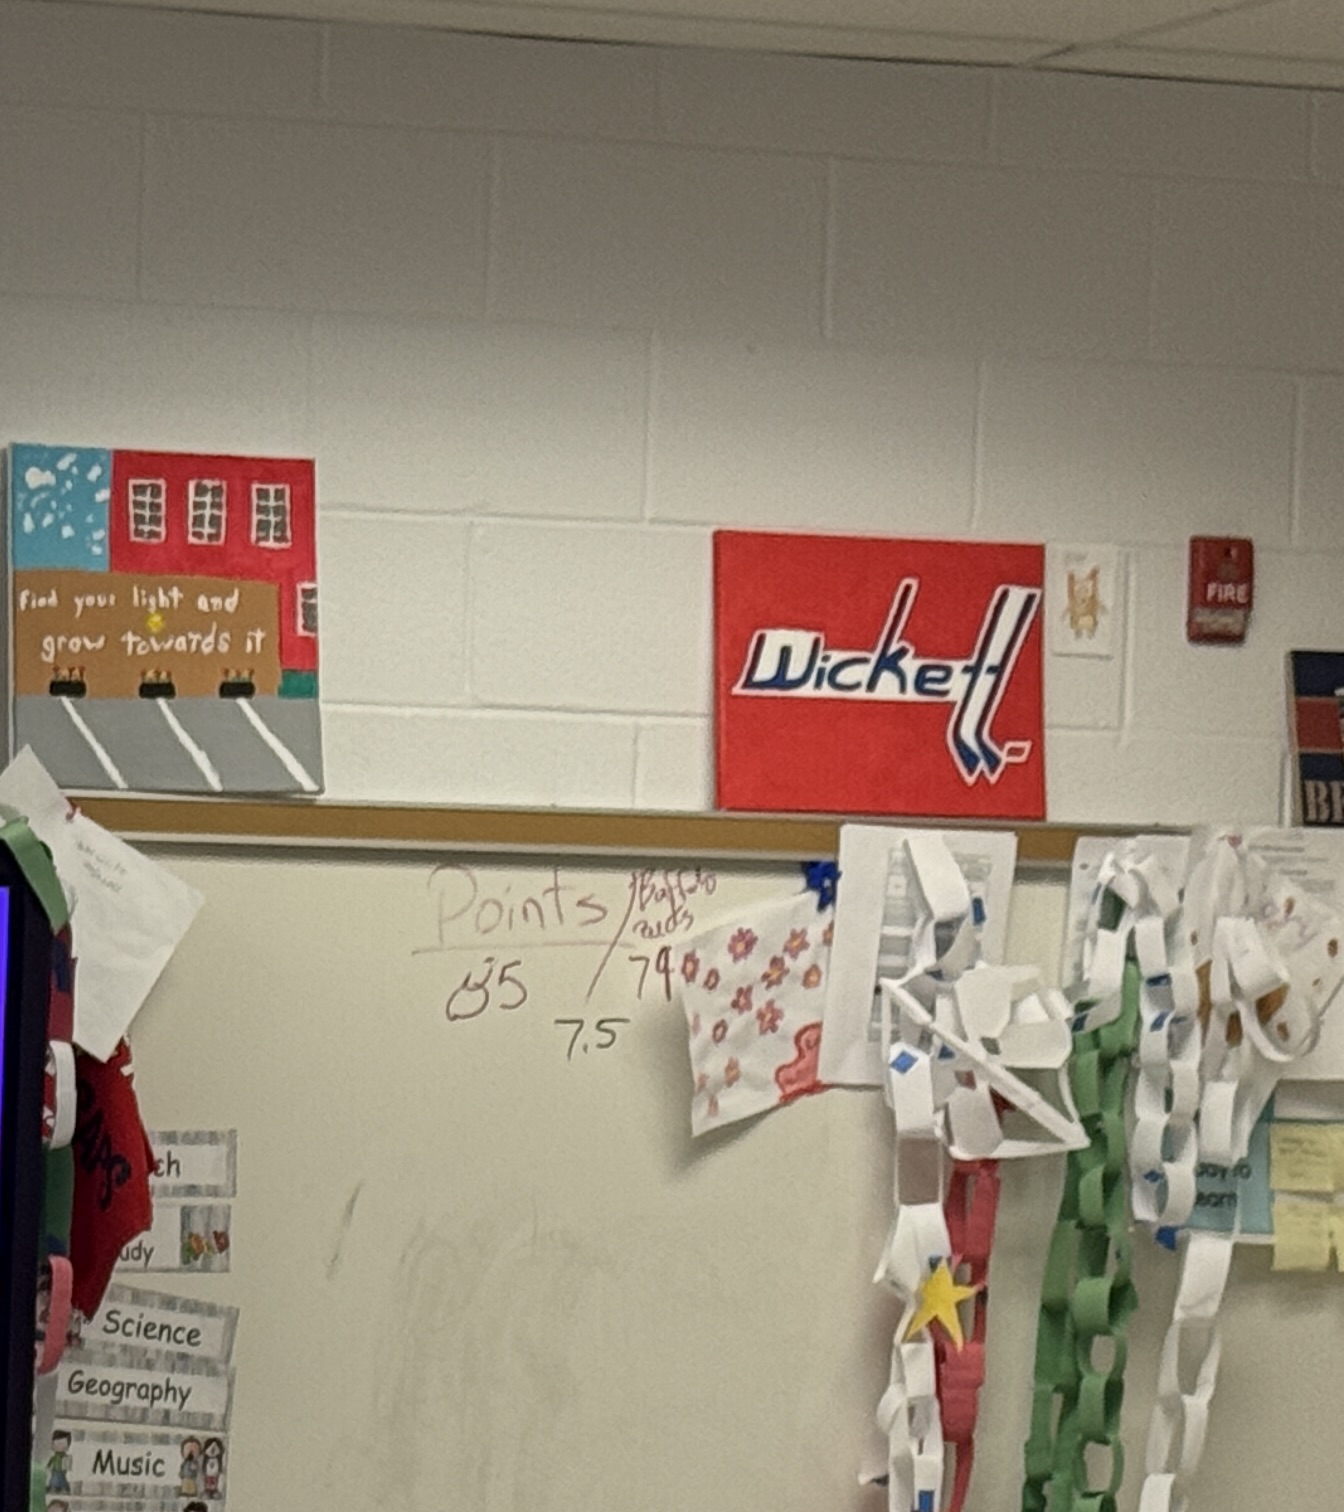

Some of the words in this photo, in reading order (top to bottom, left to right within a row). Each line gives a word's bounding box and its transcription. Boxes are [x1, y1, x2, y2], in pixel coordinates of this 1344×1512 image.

[73, 593, 116, 619] your
[131, 584, 185, 613] light
[197, 586, 240, 614] and
[1206, 581, 1250, 605] FIRE
[40, 633, 106, 664] grow
[120, 621, 232, 657] towards
[245, 627, 268, 655] it
[427, 863, 609, 949] Points
[554, 1017, 631, 1062] 7.5
[152, 1150, 182, 1179] ch
[1194, 1191, 1238, 1209] earn
[118, 1240, 155, 1268] udy
[101, 1309, 203, 1348] Science
[67, 1369, 193, 1411] Geography
[91, 1448, 166, 1478] Music
